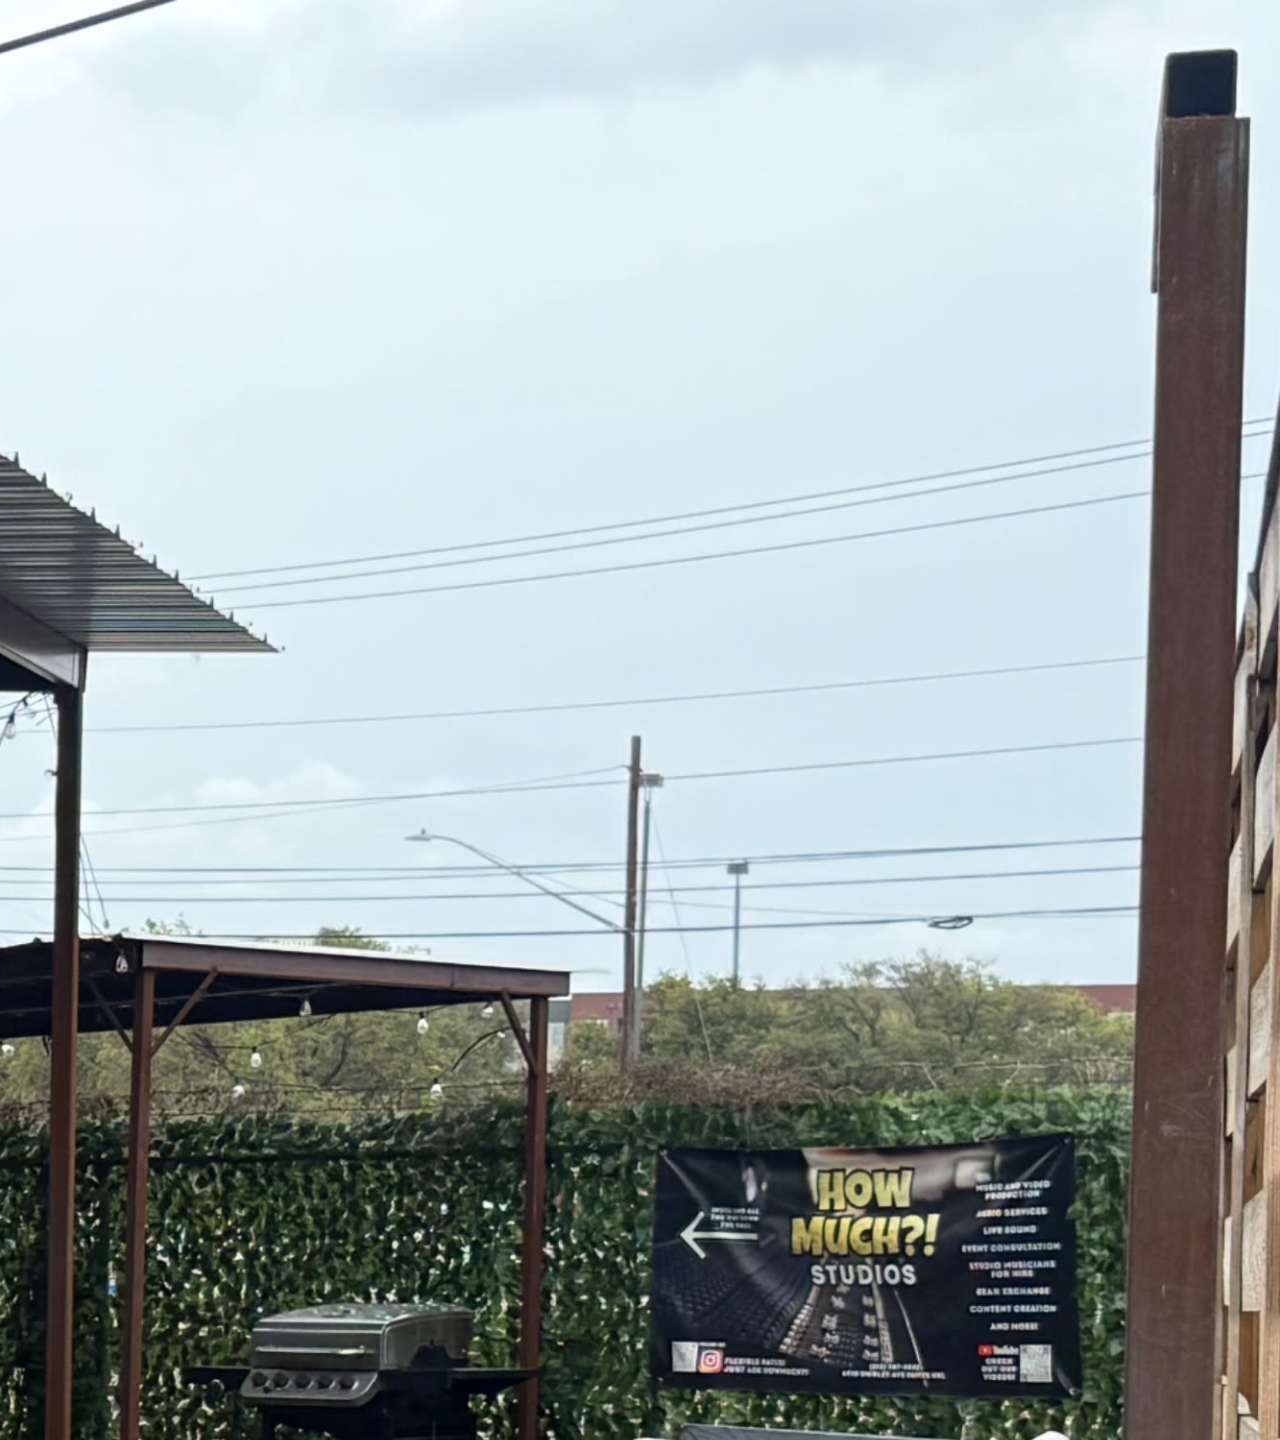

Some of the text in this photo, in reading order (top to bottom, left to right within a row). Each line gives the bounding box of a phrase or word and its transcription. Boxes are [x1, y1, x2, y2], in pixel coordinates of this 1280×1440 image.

[818, 1168, 914, 1211] HOW
[791, 1213, 940, 1256] MUCH?!
[811, 1264, 917, 1285] STUDIOS
